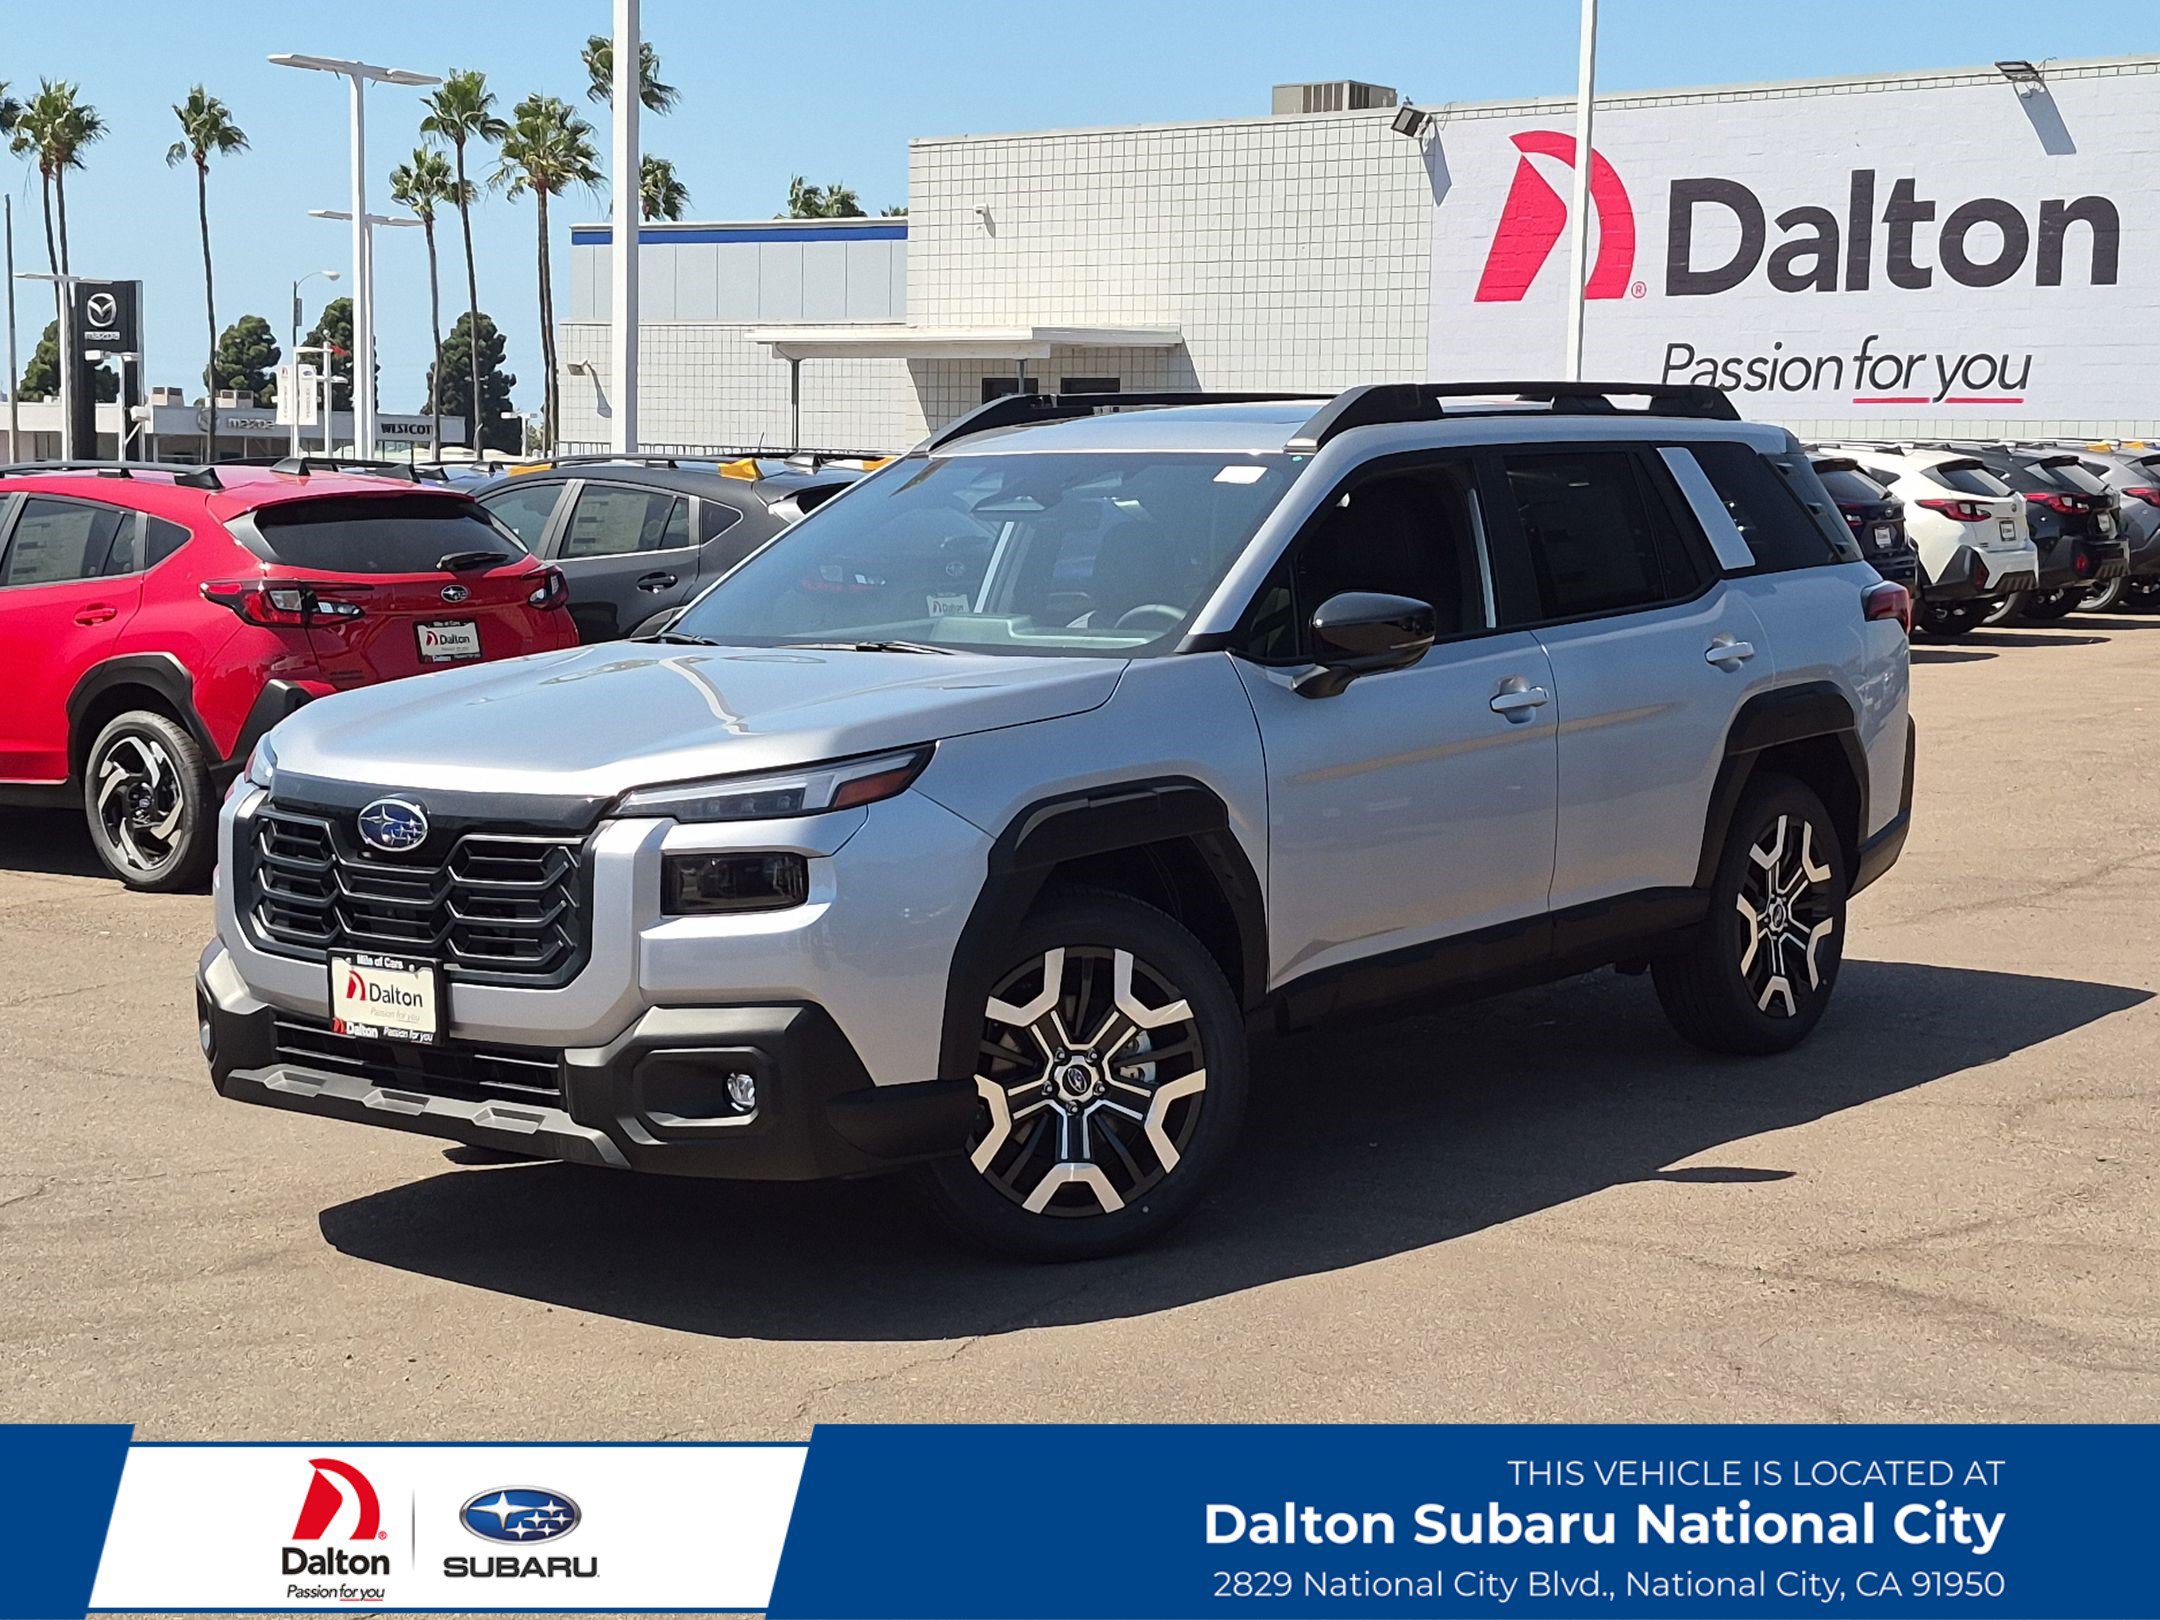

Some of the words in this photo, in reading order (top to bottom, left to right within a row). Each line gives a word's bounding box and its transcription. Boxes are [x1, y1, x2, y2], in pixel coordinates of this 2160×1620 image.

[1666, 169, 2120, 297] Dalton
[1662, 341, 1844, 392] Passion
[1852, 335, 1928, 391] for
[1934, 353, 2032, 404] you
[440, 633, 470, 646] Dalton
[374, 957, 383, 965] of
[369, 983, 423, 1008] Dalton
[371, 1007, 395, 1018] Passion
[346, 1021, 379, 1039] Dalton
[383, 1025, 409, 1038] Passion
[409, 1029, 420, 1040] for
[420, 1032, 433, 1043] you
